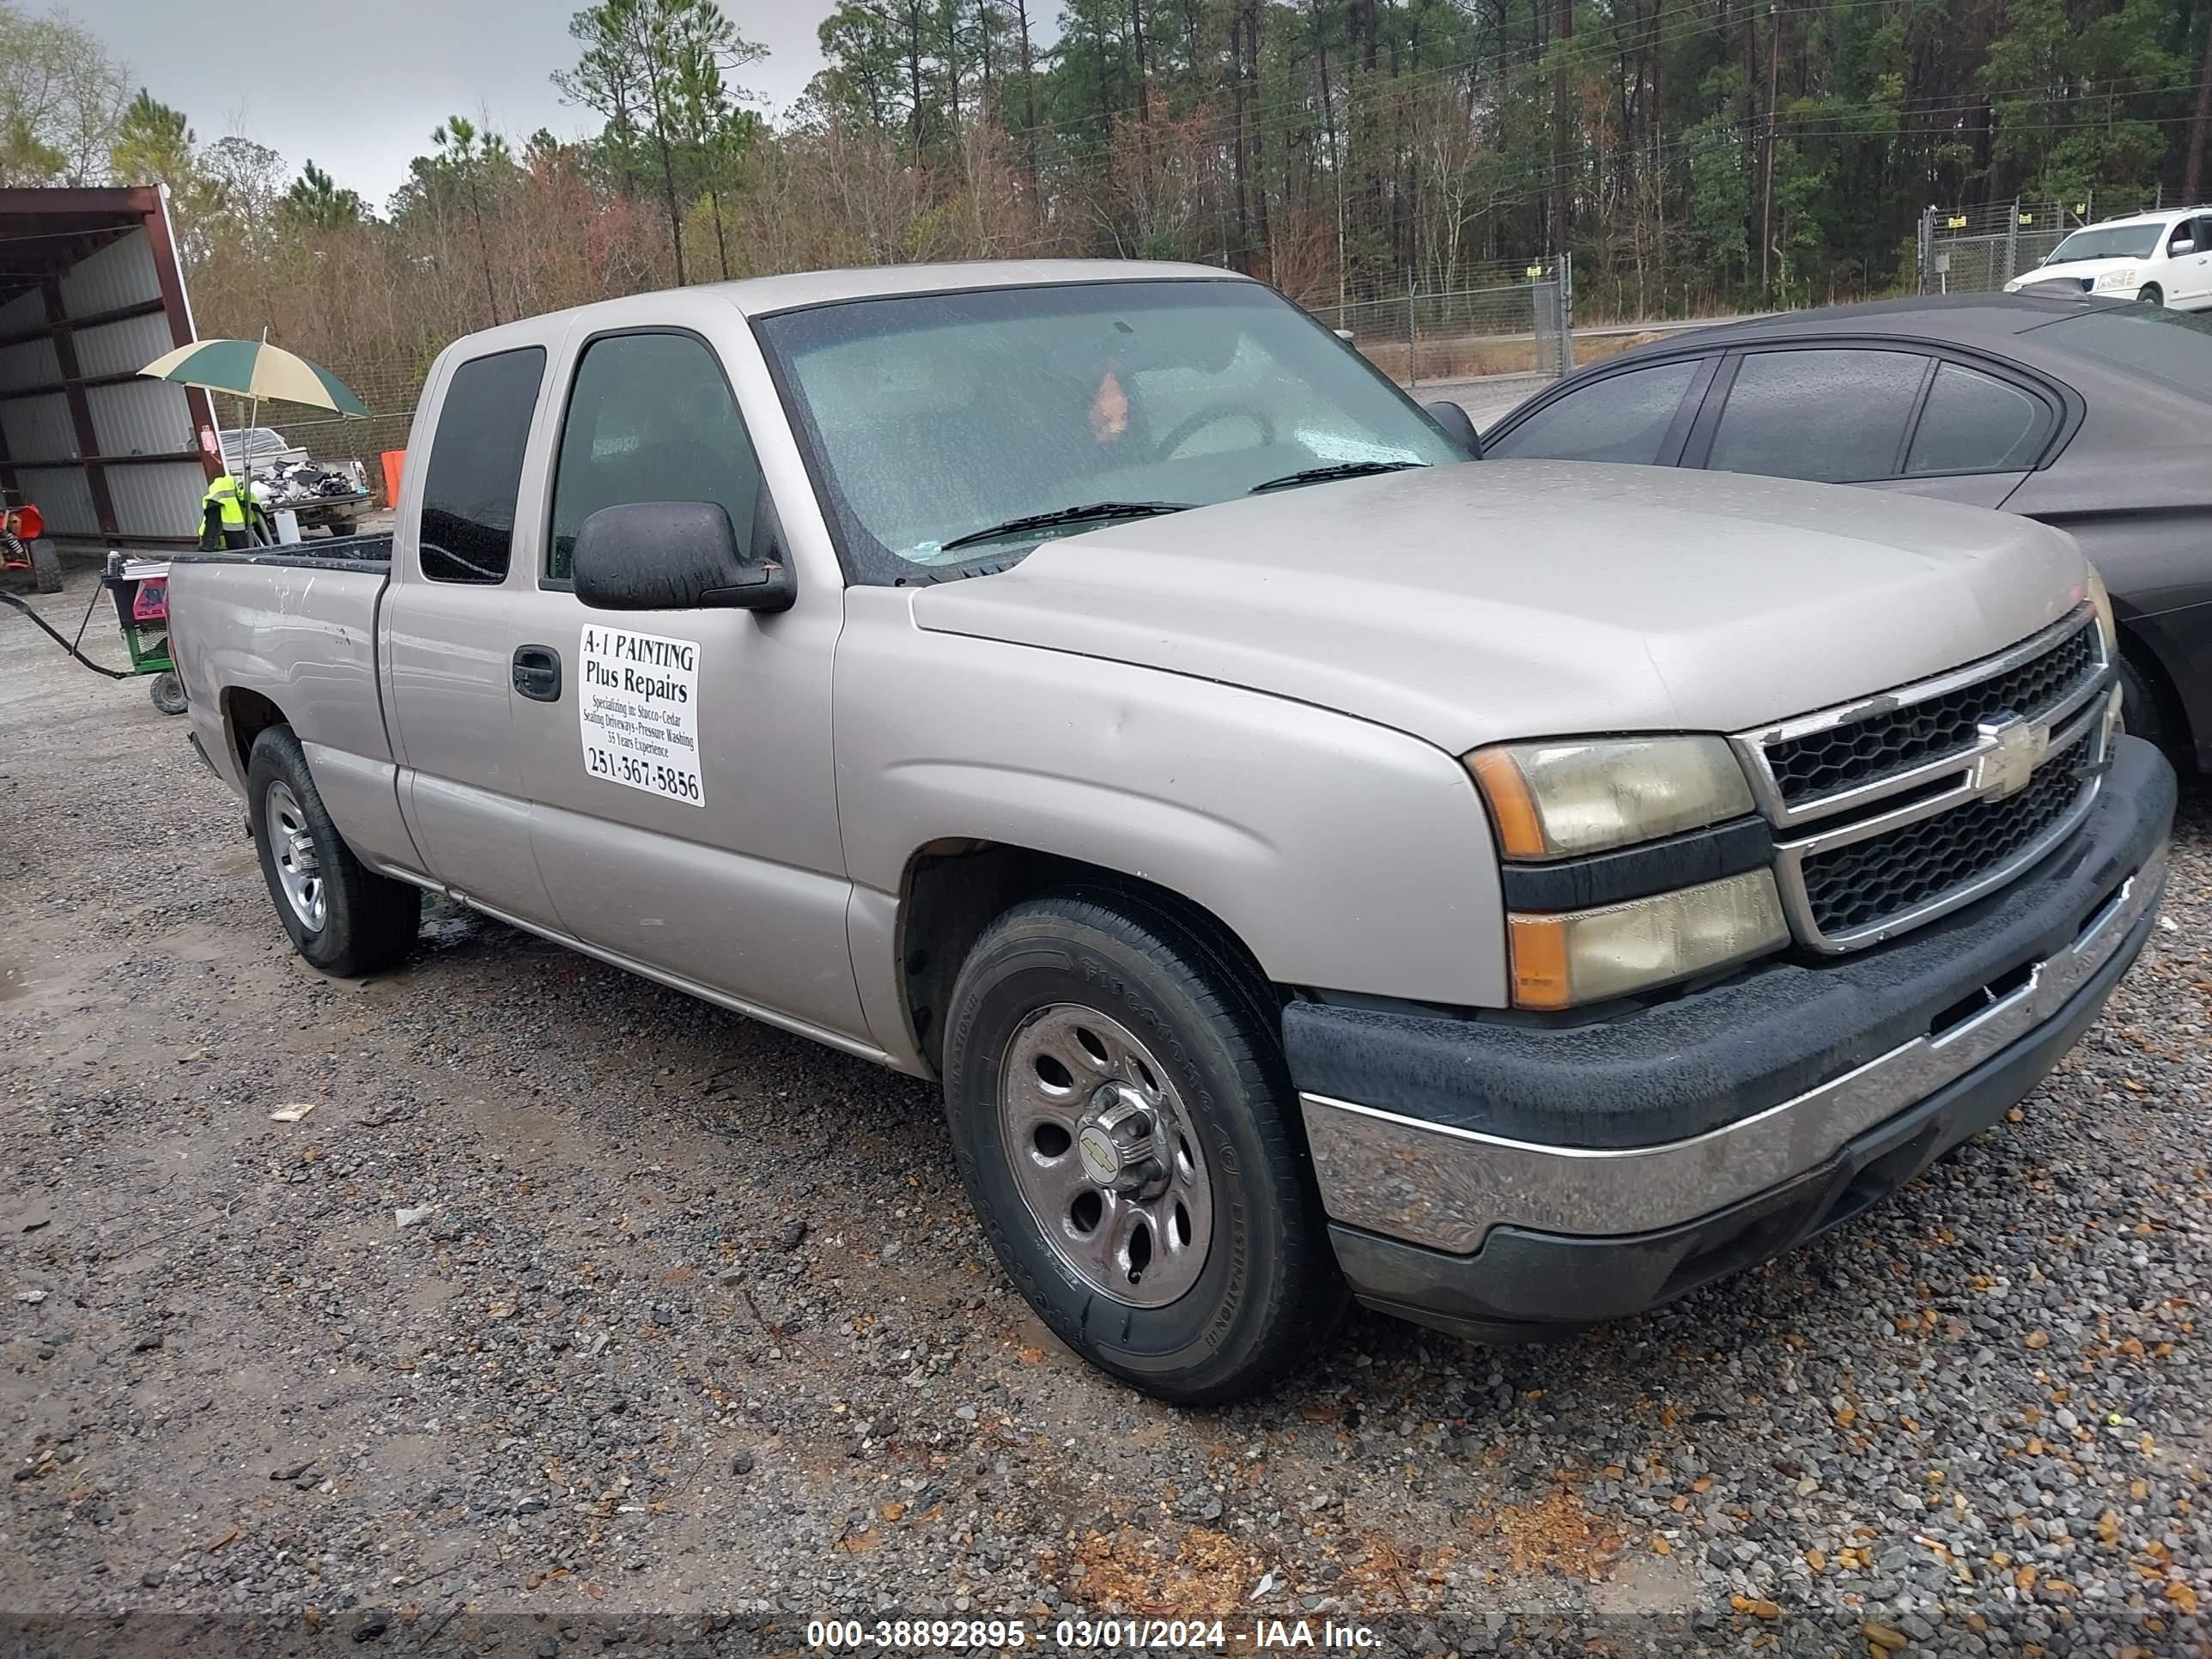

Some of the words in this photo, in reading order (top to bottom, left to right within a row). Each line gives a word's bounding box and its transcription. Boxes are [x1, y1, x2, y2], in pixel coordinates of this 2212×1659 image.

[615, 635, 694, 672] PAINTING
[586, 660, 618, 688] Plus
[624, 668, 688, 702] Repairs
[592, 695, 627, 718] Specializing
[584, 708, 605, 728] Sealing
[666, 729, 694, 751] Washing
[617, 732, 634, 749] Years
[635, 738, 669, 758] Experience
[588, 747, 699, 800] 251-367-5856
